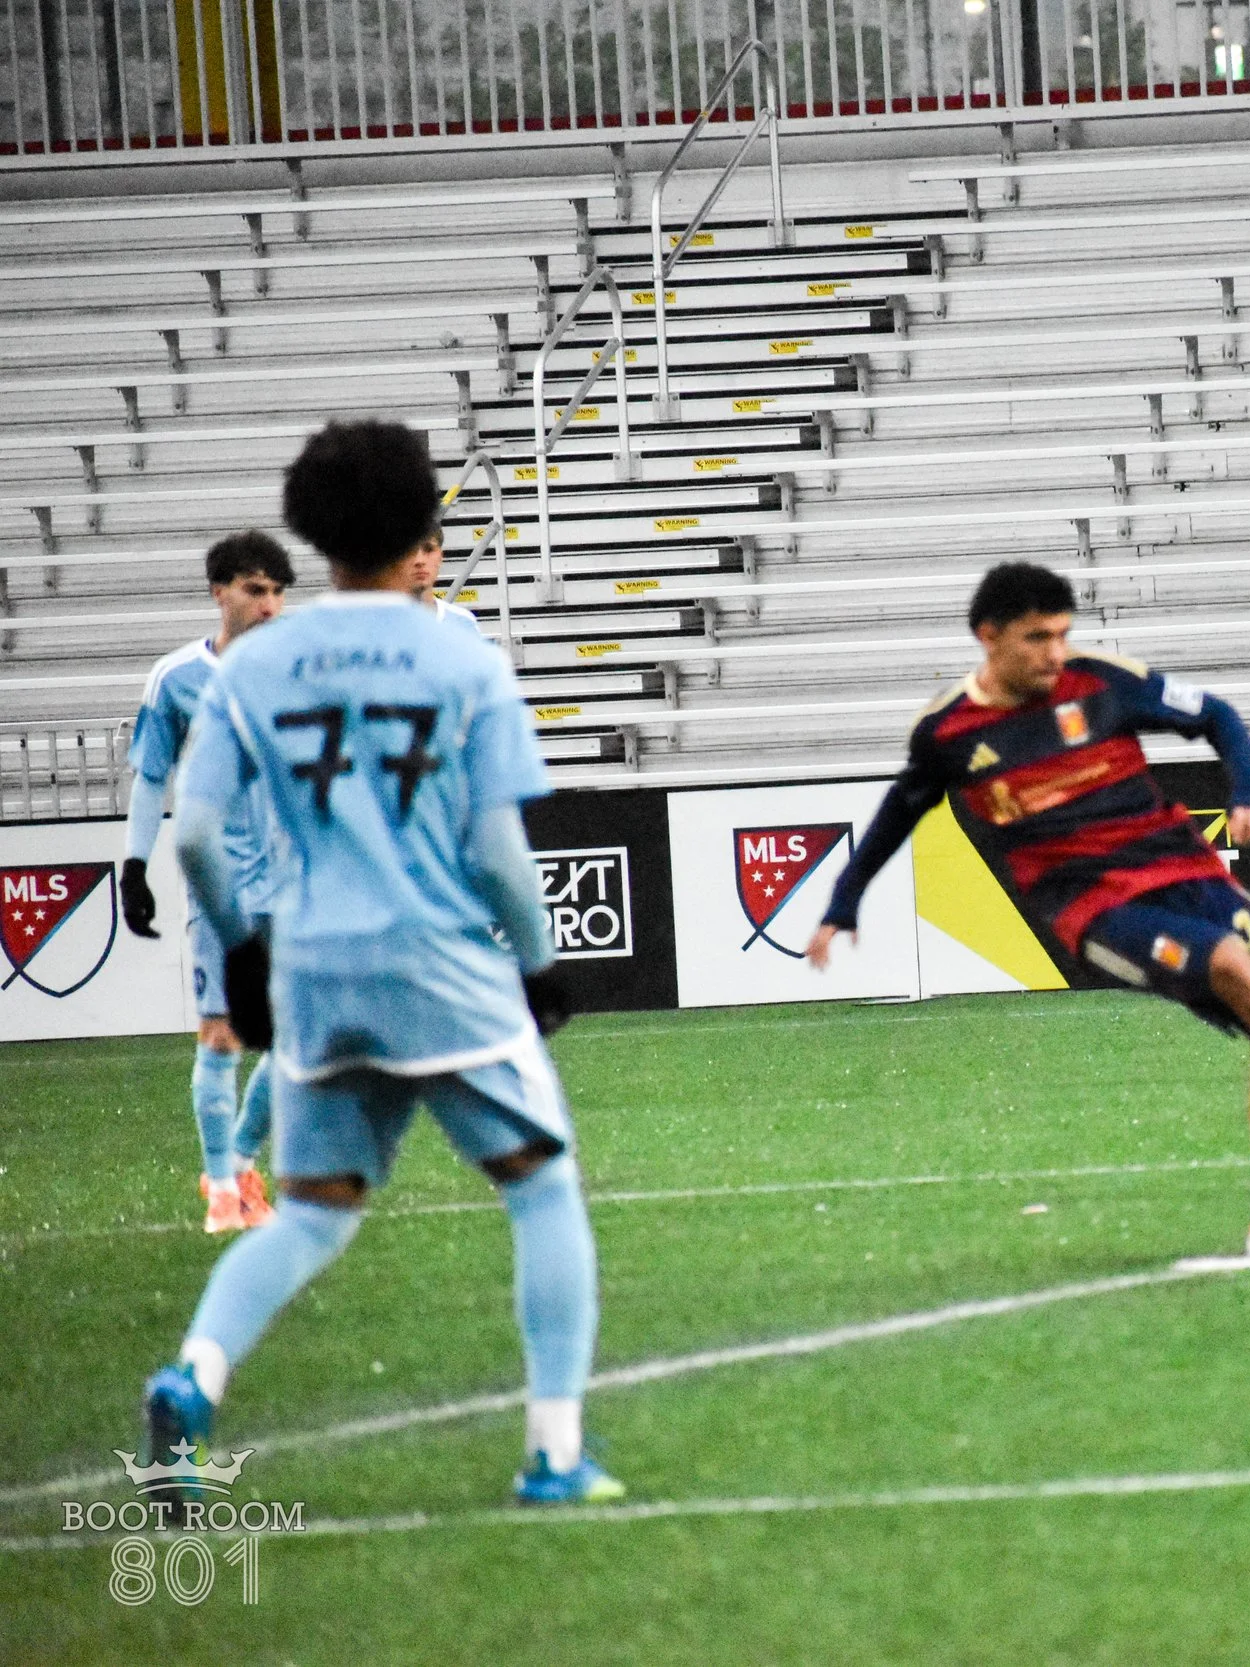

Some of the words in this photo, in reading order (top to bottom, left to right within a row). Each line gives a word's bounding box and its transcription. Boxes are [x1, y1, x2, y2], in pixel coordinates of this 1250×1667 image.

[626, 580, 658, 588] WARNING
[273, 702, 446, 828] 77
[743, 835, 807, 865] MLS
[4, 874, 68, 903] MLS
[535, 859, 615, 903] EXT
